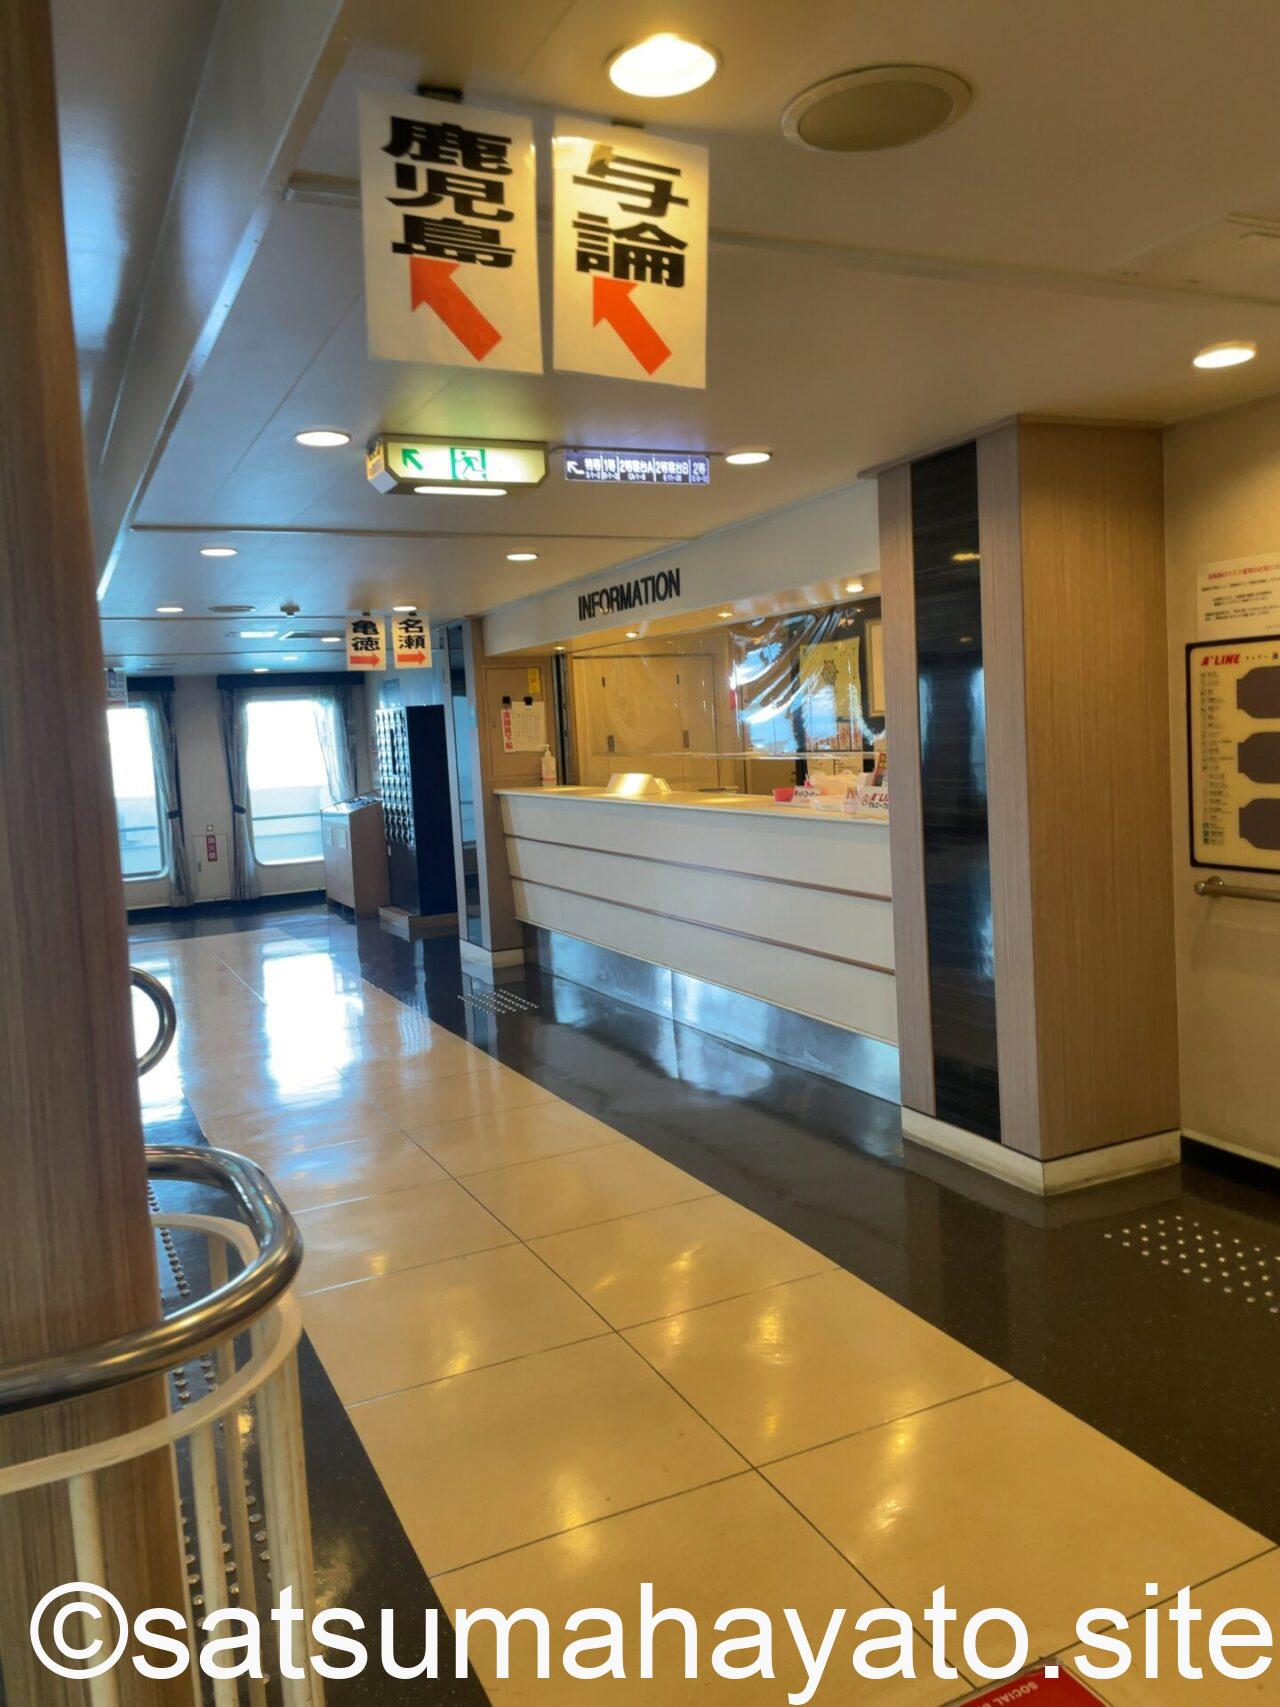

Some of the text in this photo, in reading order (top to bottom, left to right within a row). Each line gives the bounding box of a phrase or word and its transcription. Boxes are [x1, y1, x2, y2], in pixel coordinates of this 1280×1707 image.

[381, 116, 516, 268] 鹿児島
[573, 144, 689, 288] 与論
[578, 567, 680, 621] INFORMATION
[351, 620, 380, 651] 亀徳
[398, 619, 425, 649] 名瀬
[993, 1681, 1038, 1706] SOCIAL
